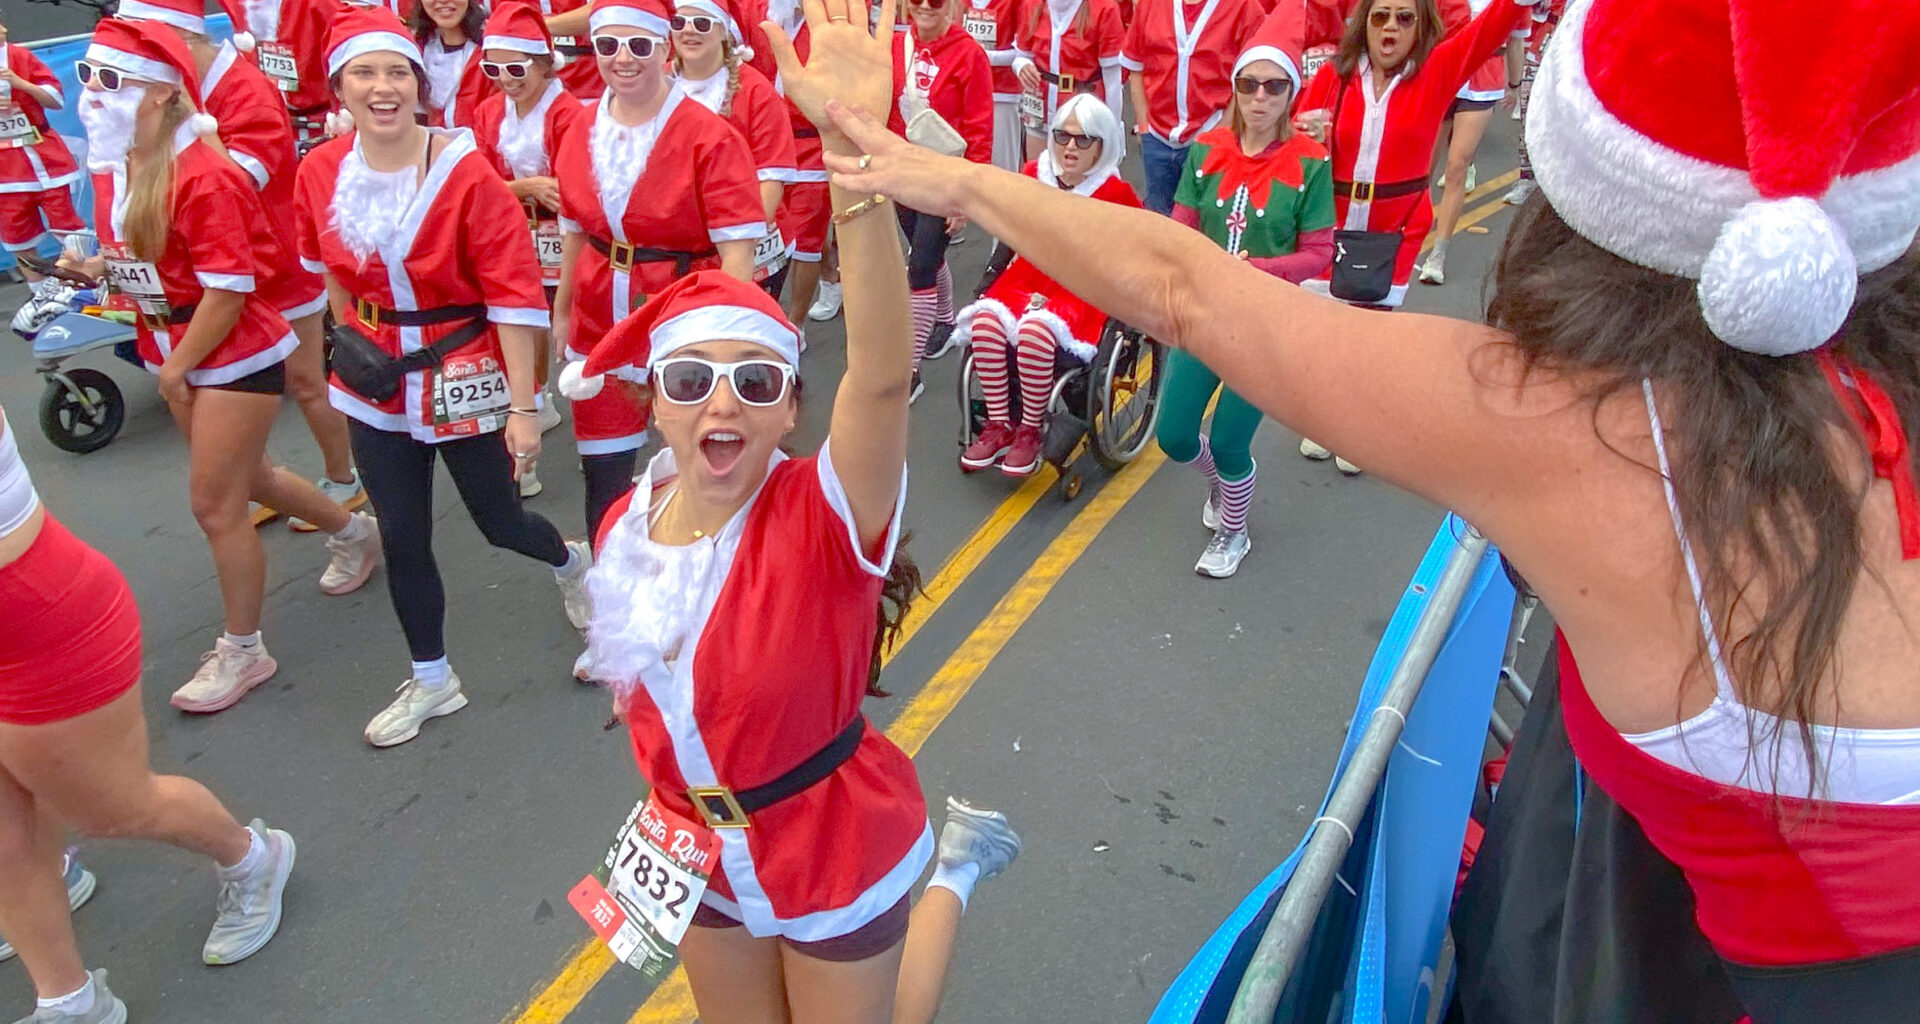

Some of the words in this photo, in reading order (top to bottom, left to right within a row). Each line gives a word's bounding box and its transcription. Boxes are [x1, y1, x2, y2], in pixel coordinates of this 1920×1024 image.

[967, 23, 994, 35] 6197
[265, 57, 294, 71] 7753
[754, 234, 779, 257] 277
[449, 377, 506, 405] 9254
[670, 828, 709, 867] Run
[619, 837, 691, 919] 7832
[590, 903, 612, 929] 7832
